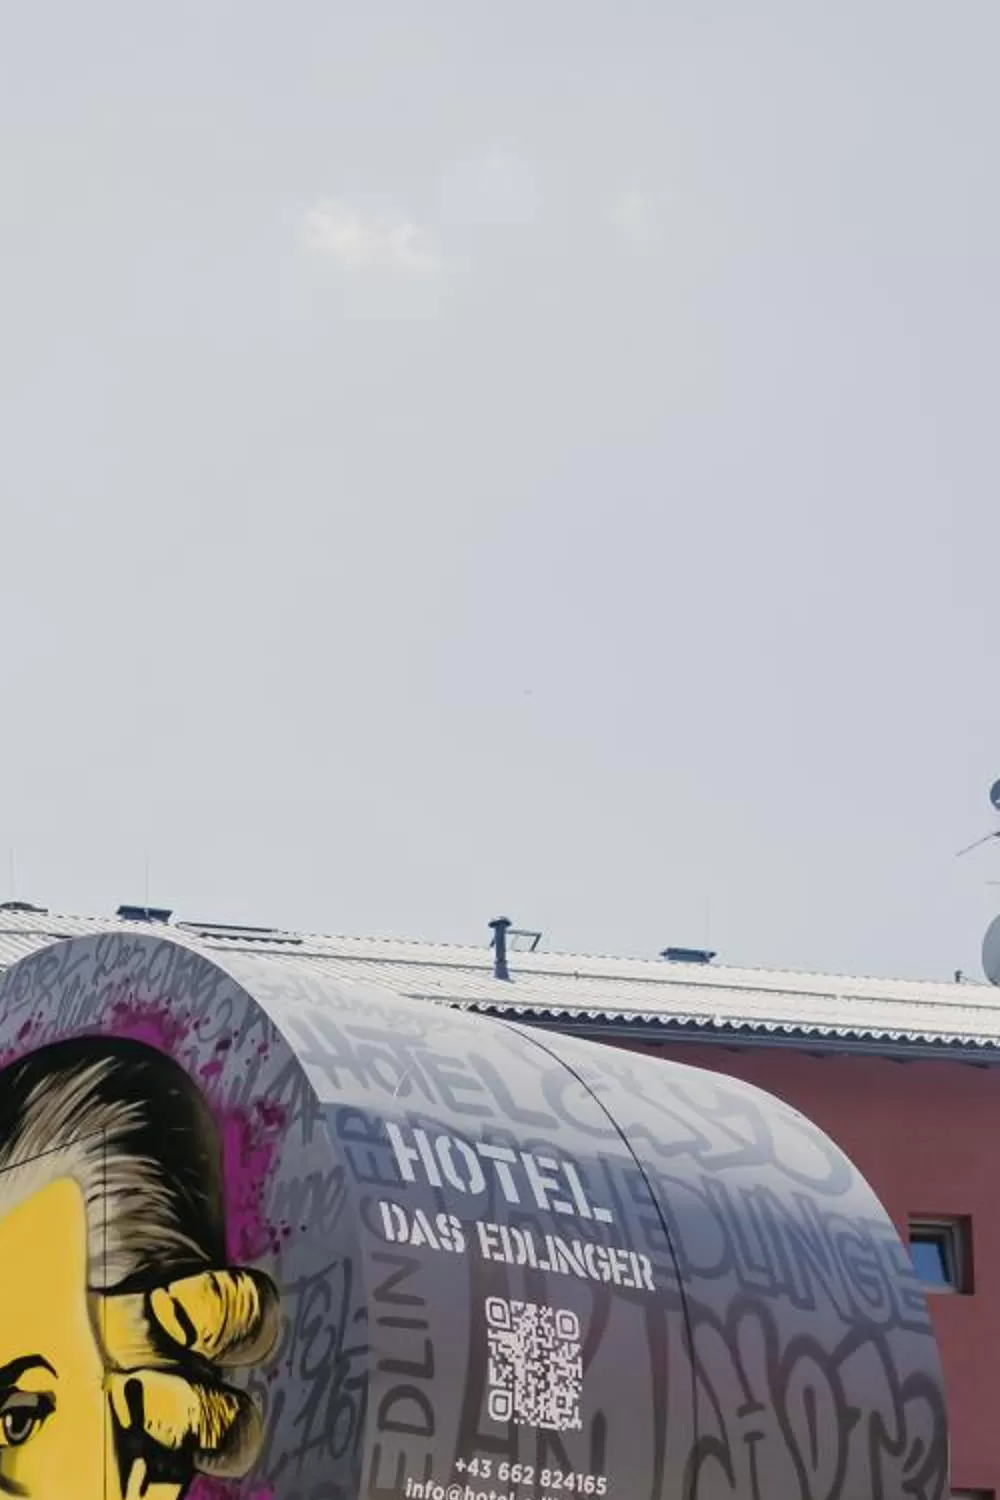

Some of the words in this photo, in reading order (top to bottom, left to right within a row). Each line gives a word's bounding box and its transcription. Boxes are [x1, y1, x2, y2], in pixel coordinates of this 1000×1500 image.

[385, 1121, 615, 1225] HOTEL
[379, 1202, 465, 1253] DAS
[476, 1220, 656, 1291] EDLINGER
[454, 1456, 493, 1480] +43
[497, 1461, 534, 1486] 662
[539, 1468, 609, 1496] 824165
